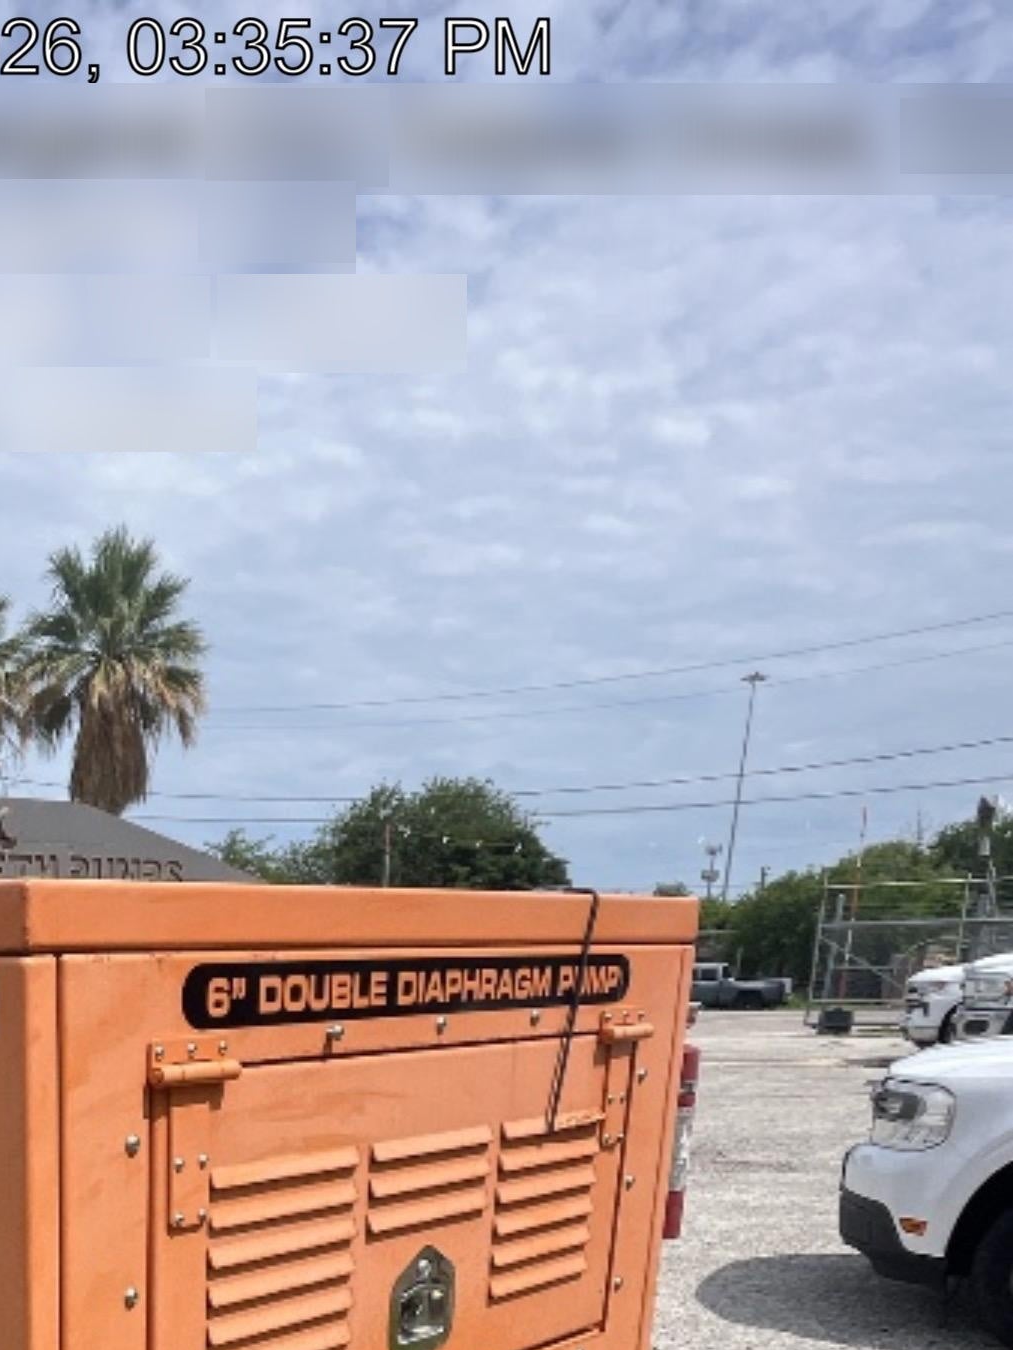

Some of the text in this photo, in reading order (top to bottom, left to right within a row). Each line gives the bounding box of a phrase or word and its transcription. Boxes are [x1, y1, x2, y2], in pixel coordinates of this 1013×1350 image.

[70, 854, 183, 882] PUMPS
[207, 976, 246, 1018] 6"
[258, 969, 388, 1014] DOUBLE
[396, 965, 552, 1006] DIAPHRAGM
